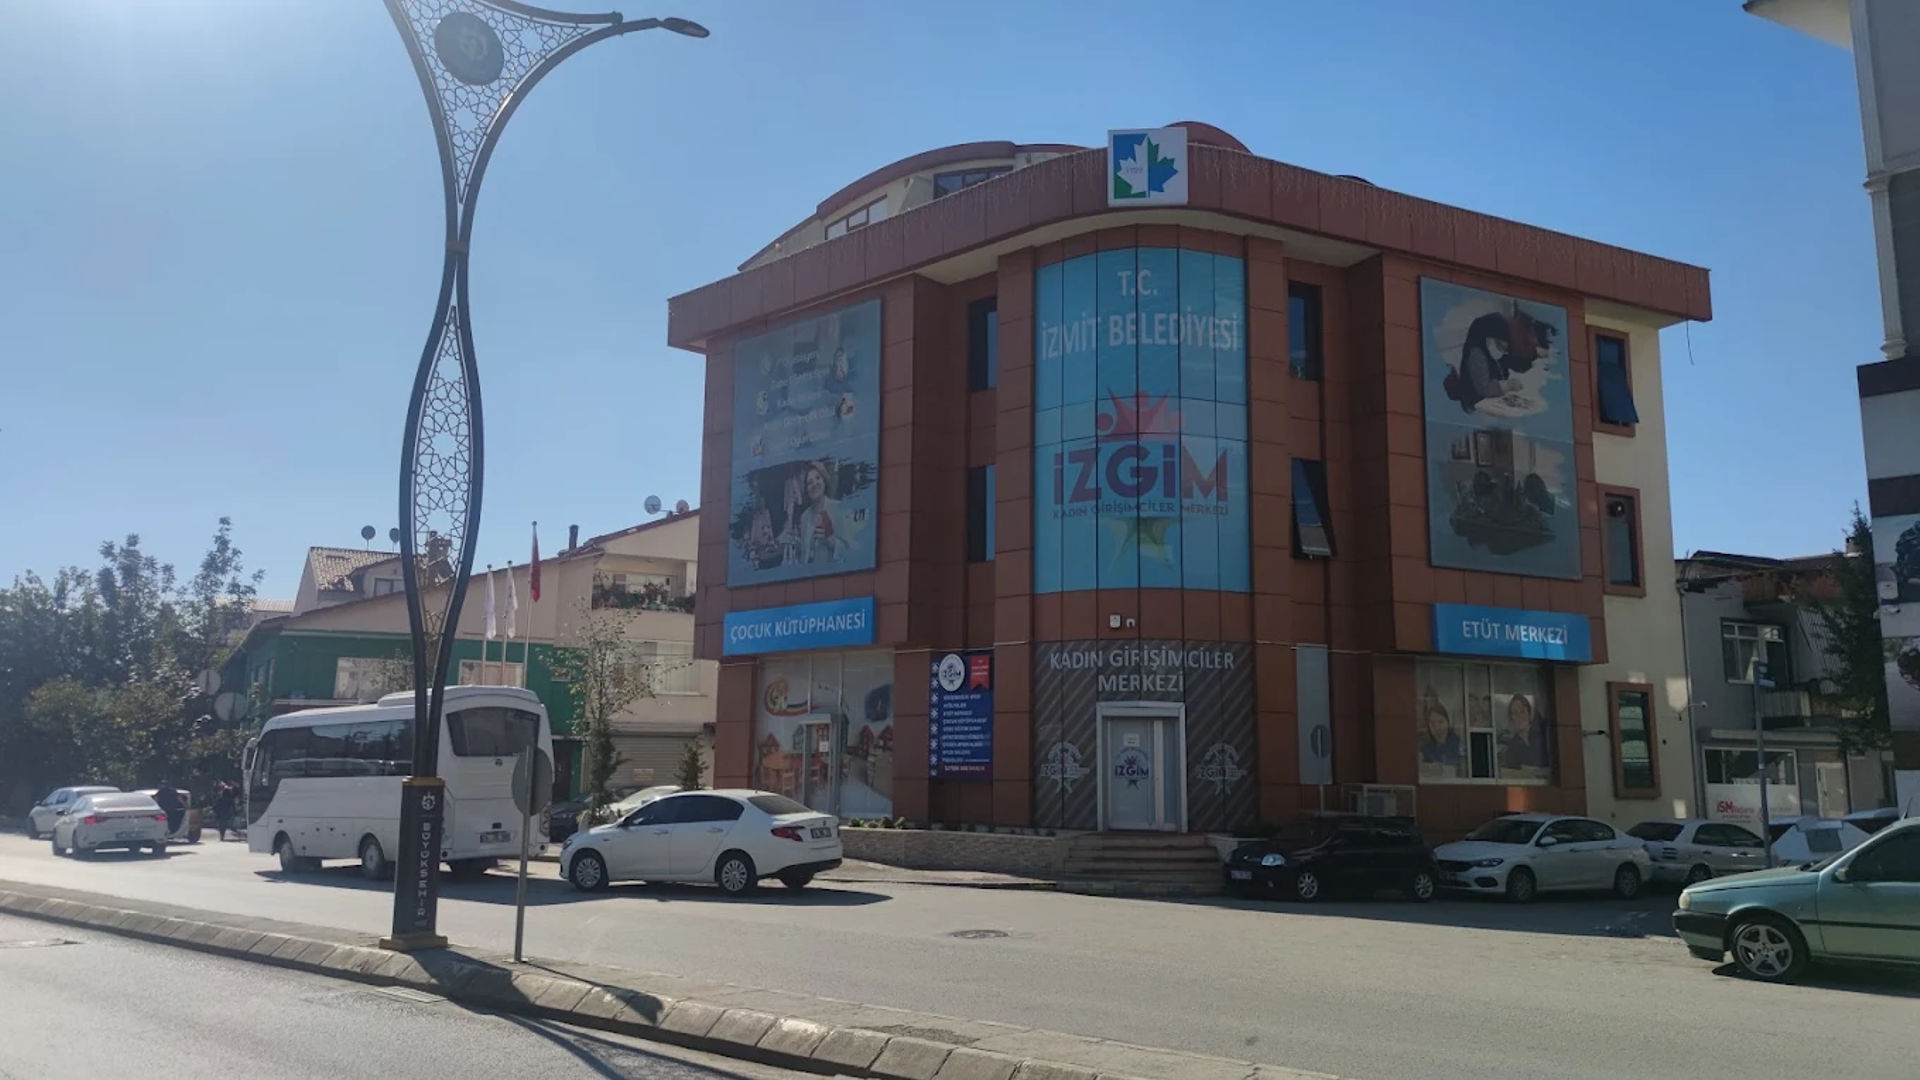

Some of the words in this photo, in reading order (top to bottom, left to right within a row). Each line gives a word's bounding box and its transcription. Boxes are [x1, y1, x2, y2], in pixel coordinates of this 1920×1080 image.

[1117, 269, 1158, 296] T.C.
[1042, 312, 1101, 359] İZMİT
[1109, 305, 1238, 352] BELEDİYESİ
[1053, 505, 1088, 519] KADIN
[1180, 502, 1229, 516] MERKEZİ
[730, 621, 773, 645] ÇOCUK
[775, 608, 866, 637] KÜTÜPHANESİ
[1462, 617, 1501, 641] ETÜT
[1505, 624, 1568, 646] MERKEZİ
[1050, 651, 1101, 670] KADIN
[1109, 645, 1235, 671] GİRİŞİMCİLER
[1098, 671, 1184, 693] MERKEZİ
